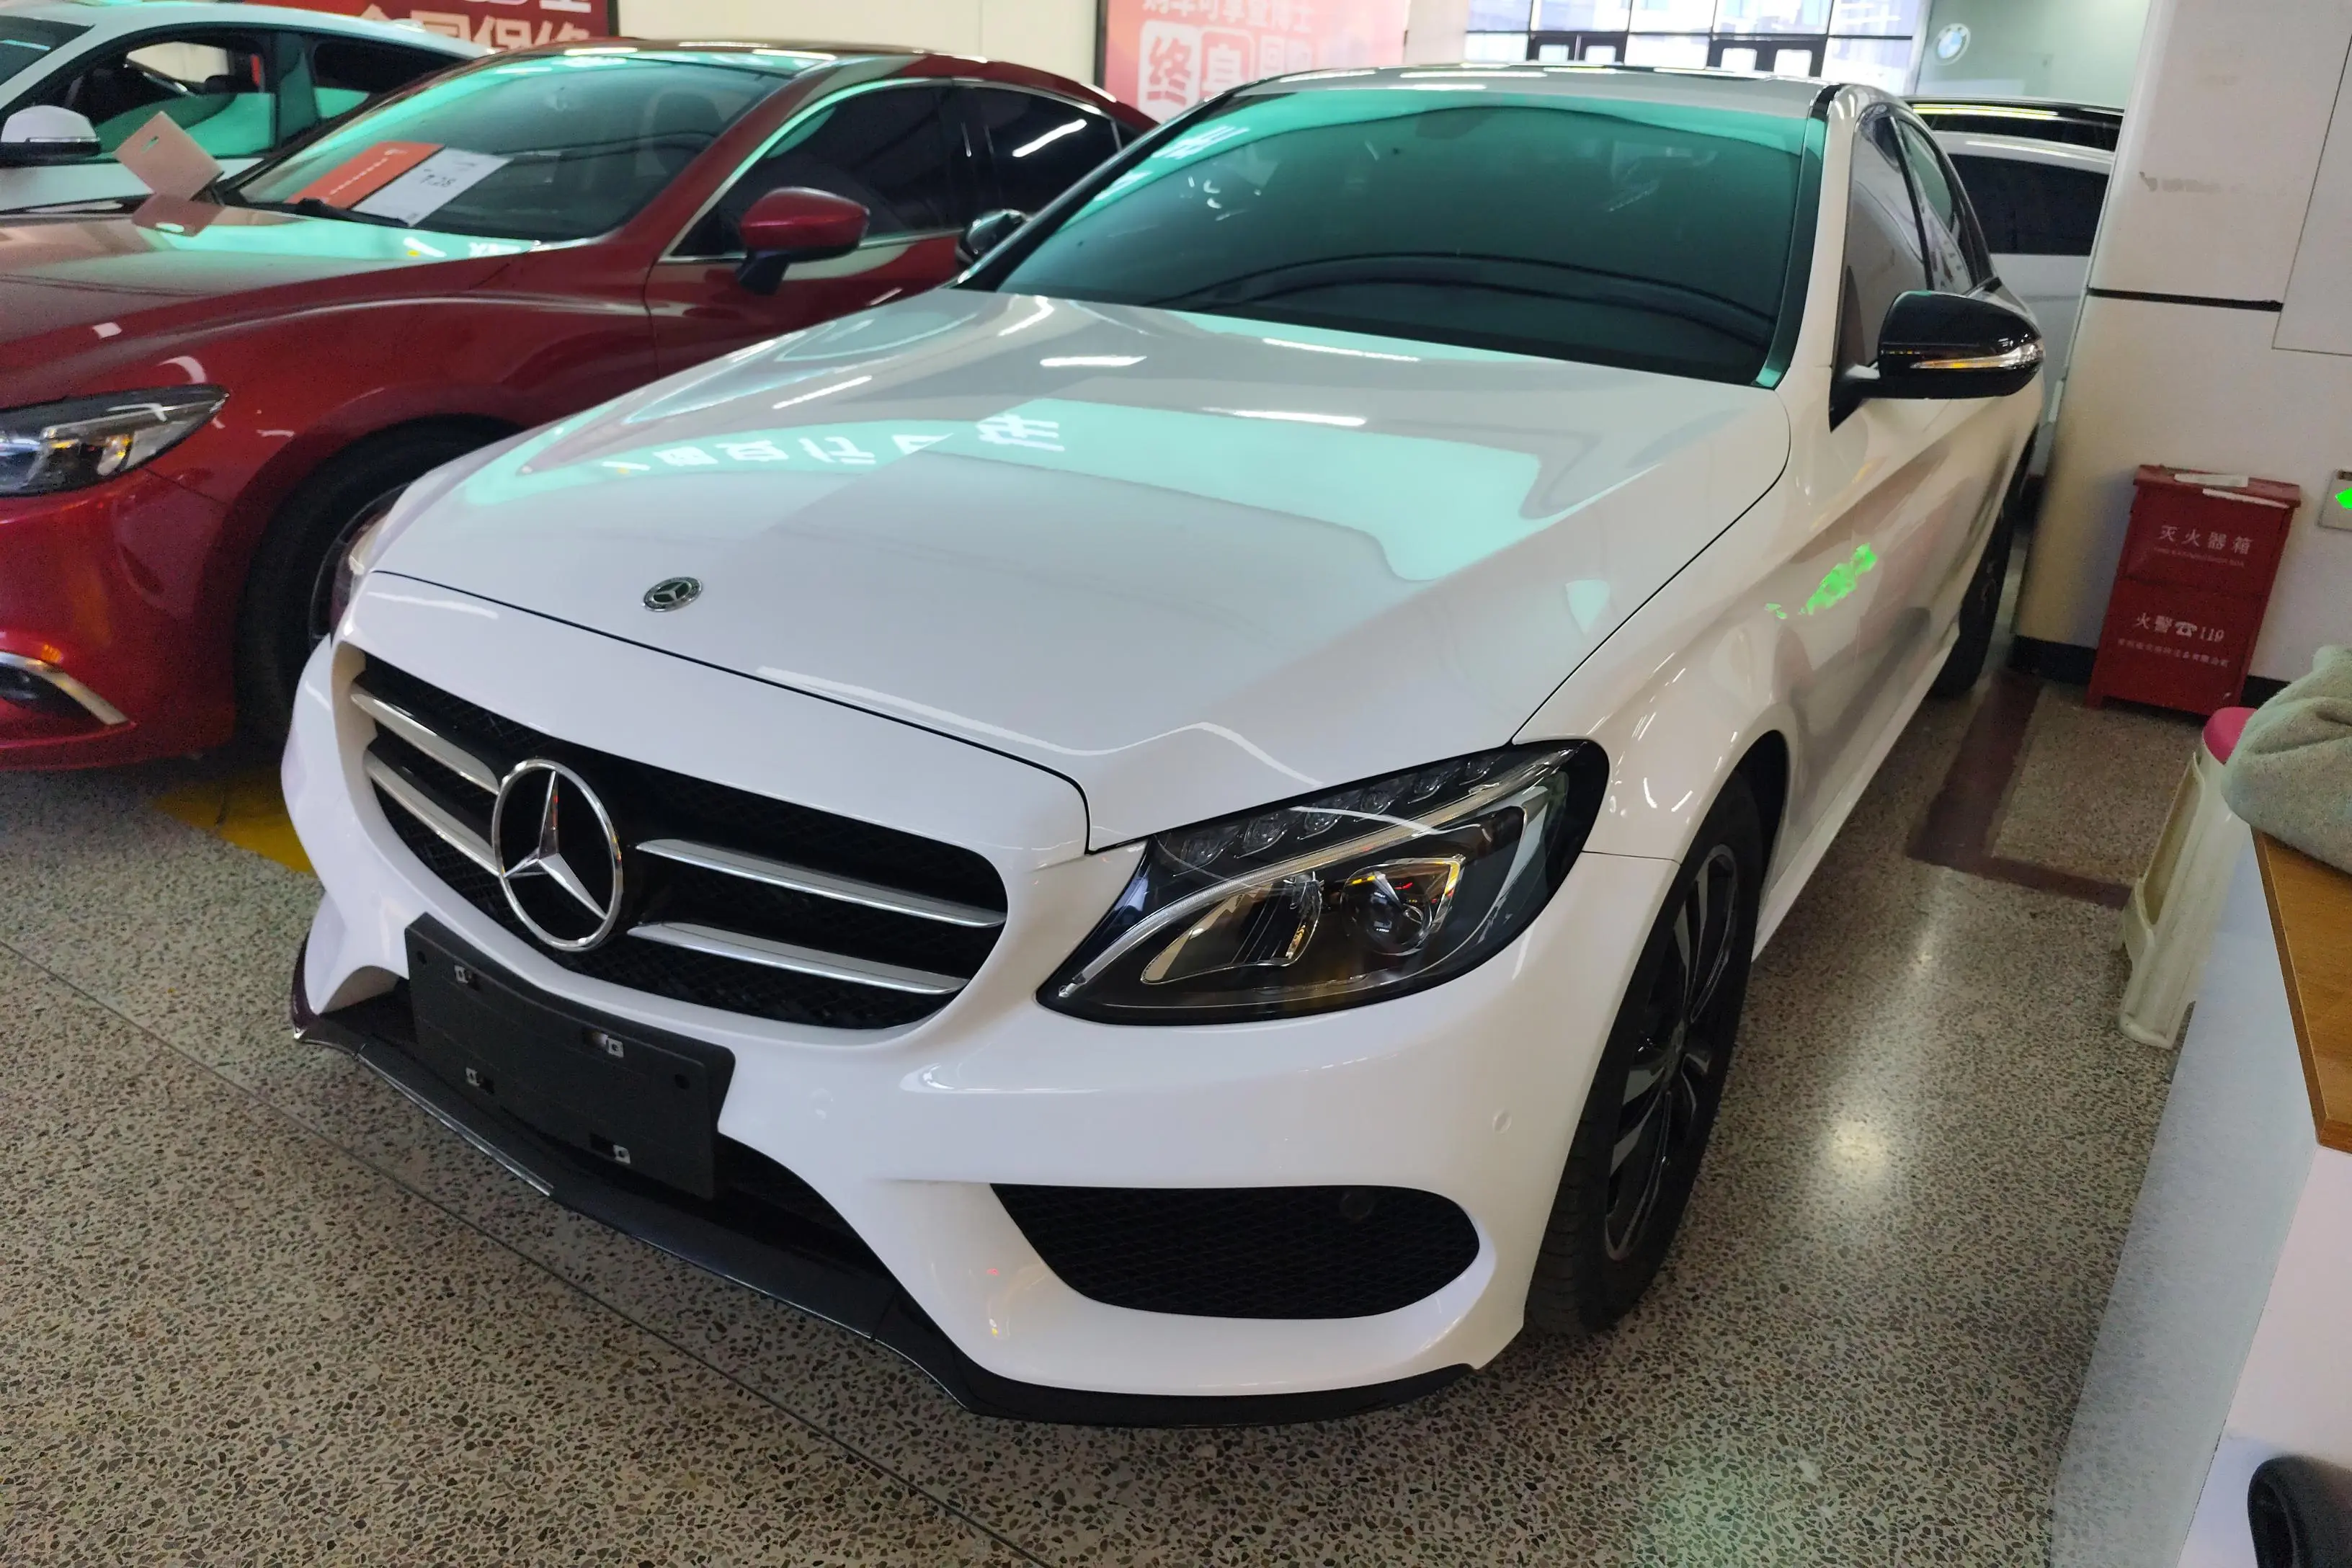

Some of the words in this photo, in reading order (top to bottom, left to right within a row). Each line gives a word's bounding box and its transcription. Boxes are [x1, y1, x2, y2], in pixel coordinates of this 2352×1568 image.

[360, 4, 590, 48] 国保
[2158, 525, 2253, 555] 灭火器箱
[2200, 626, 2224, 642] 119
